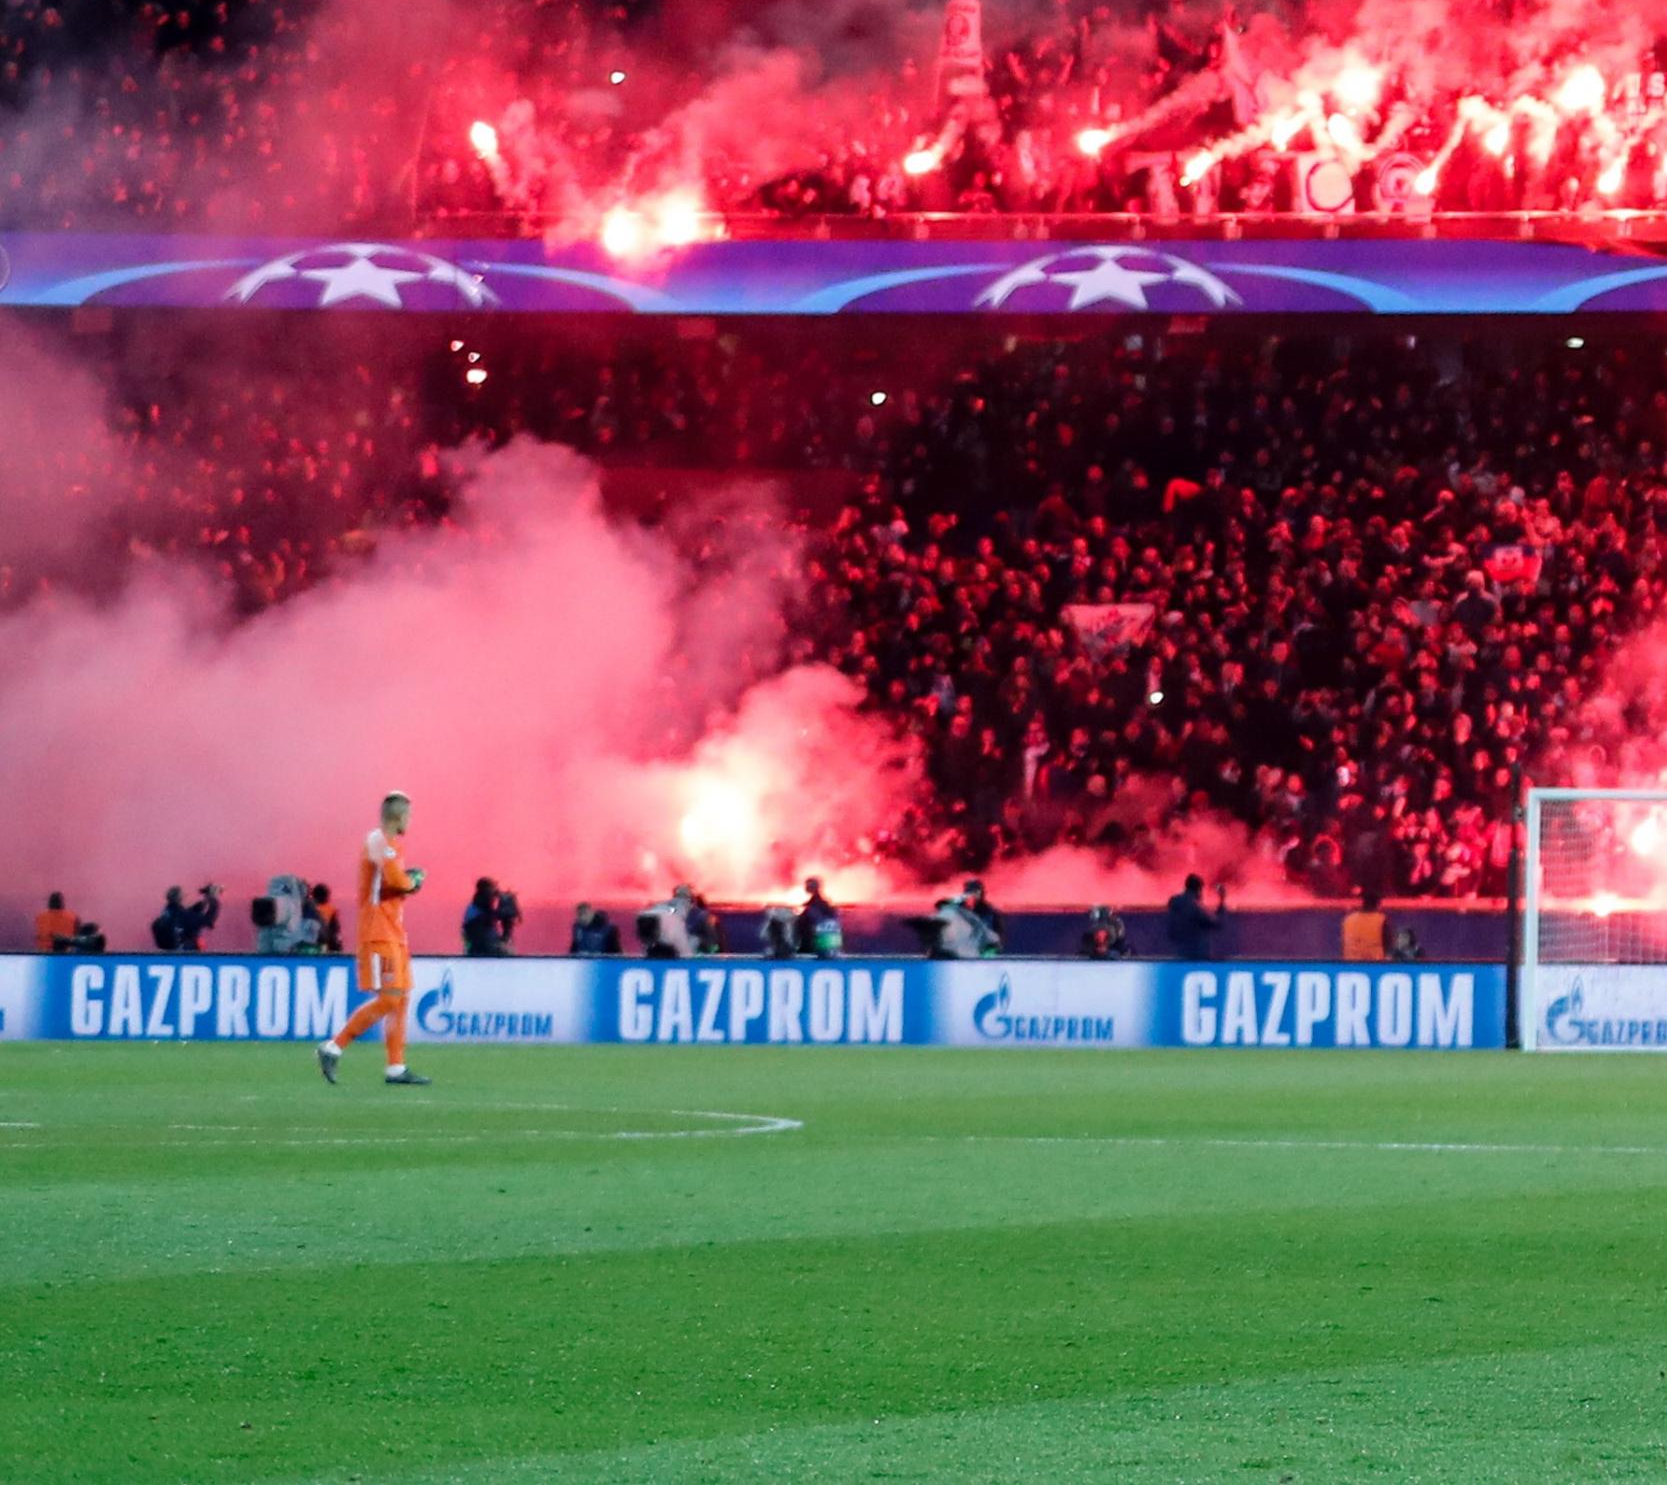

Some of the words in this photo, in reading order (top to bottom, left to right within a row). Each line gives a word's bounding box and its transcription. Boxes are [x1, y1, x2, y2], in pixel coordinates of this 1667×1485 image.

[71, 964, 348, 1037] GAZPROM
[456, 1011, 553, 1037] GAZPROM
[619, 968, 904, 1042] GAZPROM
[1014, 1016, 1114, 1041] GAZPROM
[1181, 970, 1474, 1046] GAZPROM
